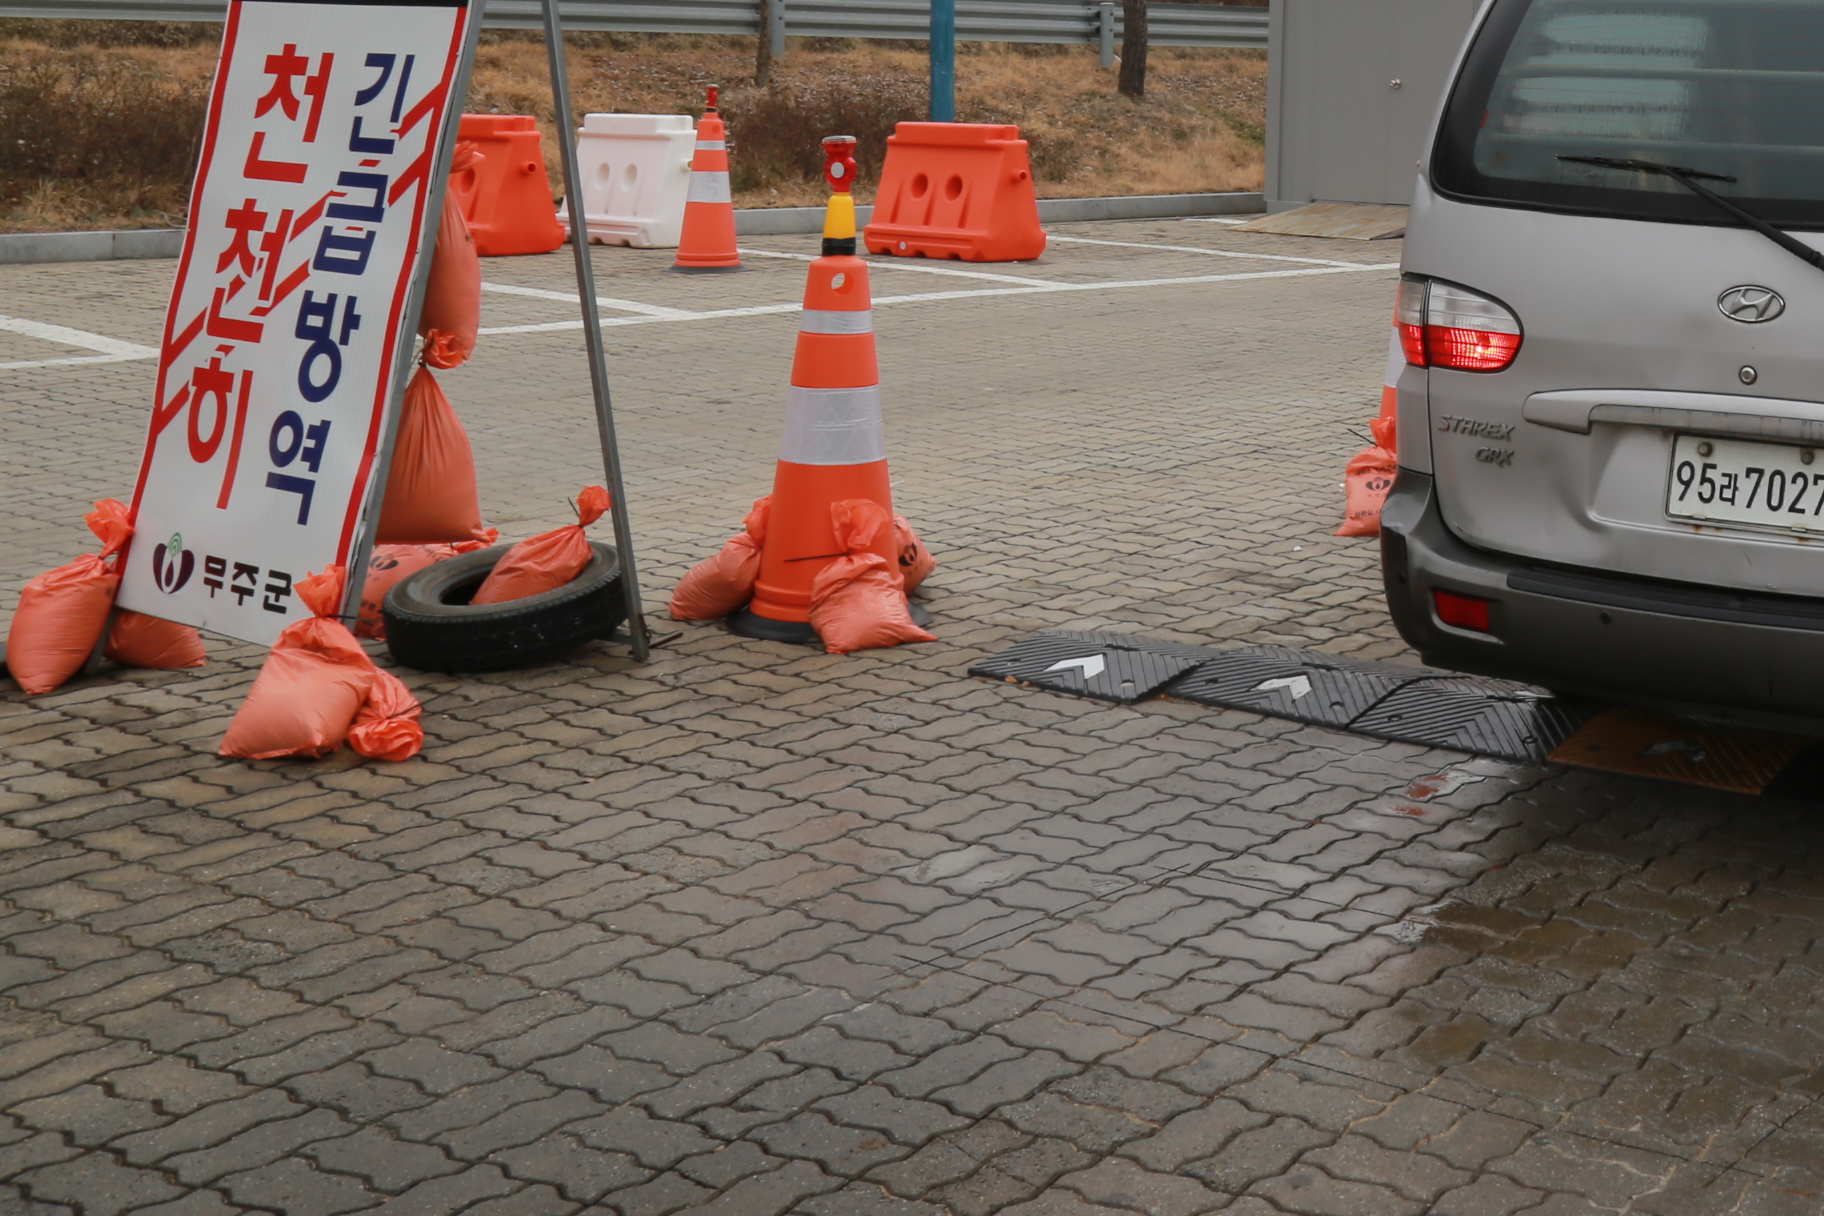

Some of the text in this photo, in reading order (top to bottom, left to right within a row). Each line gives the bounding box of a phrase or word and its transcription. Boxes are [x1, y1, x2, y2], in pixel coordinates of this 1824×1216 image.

[187, 43, 335, 510] 천천히
[266, 53, 416, 525] 긴급방역
[1438, 415, 1515, 441] STAREX
[1476, 446, 1515, 467] GRX
[203, 555, 292, 614] 무주군
